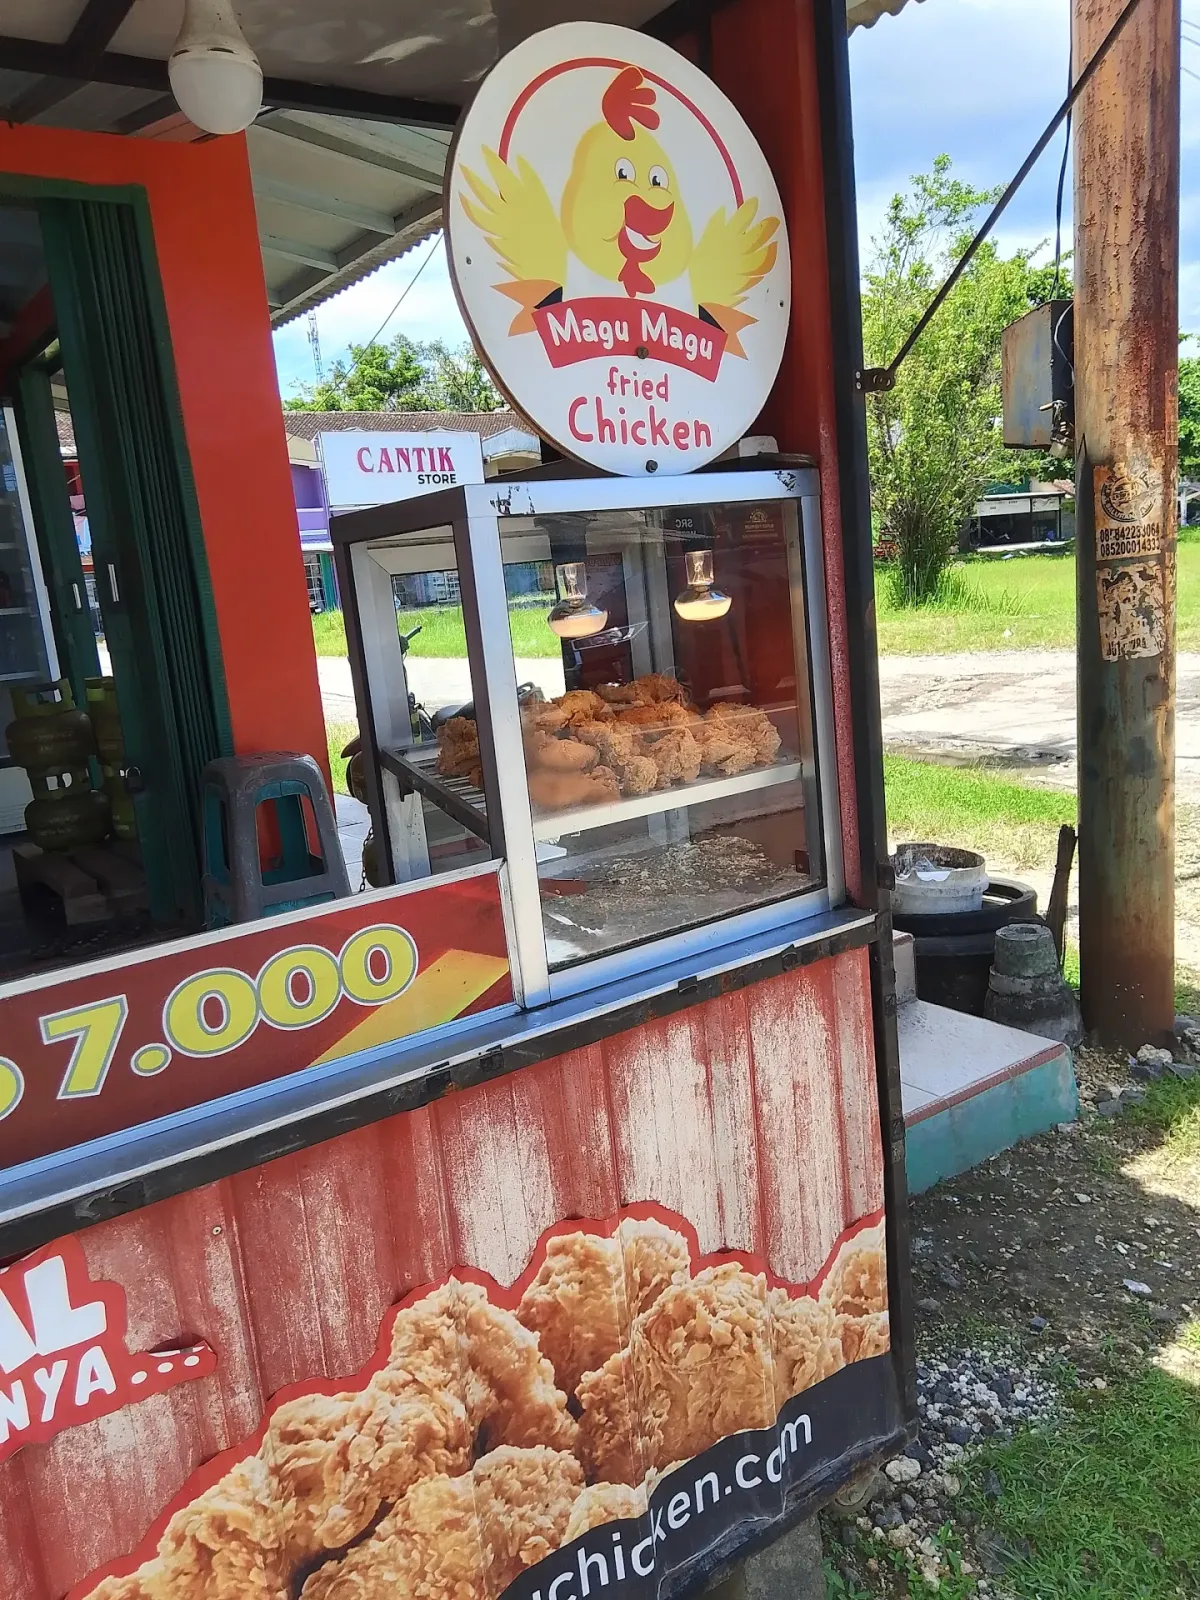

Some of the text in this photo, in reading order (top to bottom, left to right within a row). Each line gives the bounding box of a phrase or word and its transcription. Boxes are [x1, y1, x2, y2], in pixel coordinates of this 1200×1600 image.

[546, 307, 714, 361] Magu Magu
[607, 366, 670, 403] fried
[568, 396, 713, 451] Chicken
[356, 446, 456, 473] CANTIK
[417, 473, 457, 485] STORE
[38, 922, 419, 1100] 7.000
[532, 1413, 813, 1600] chicken.com
